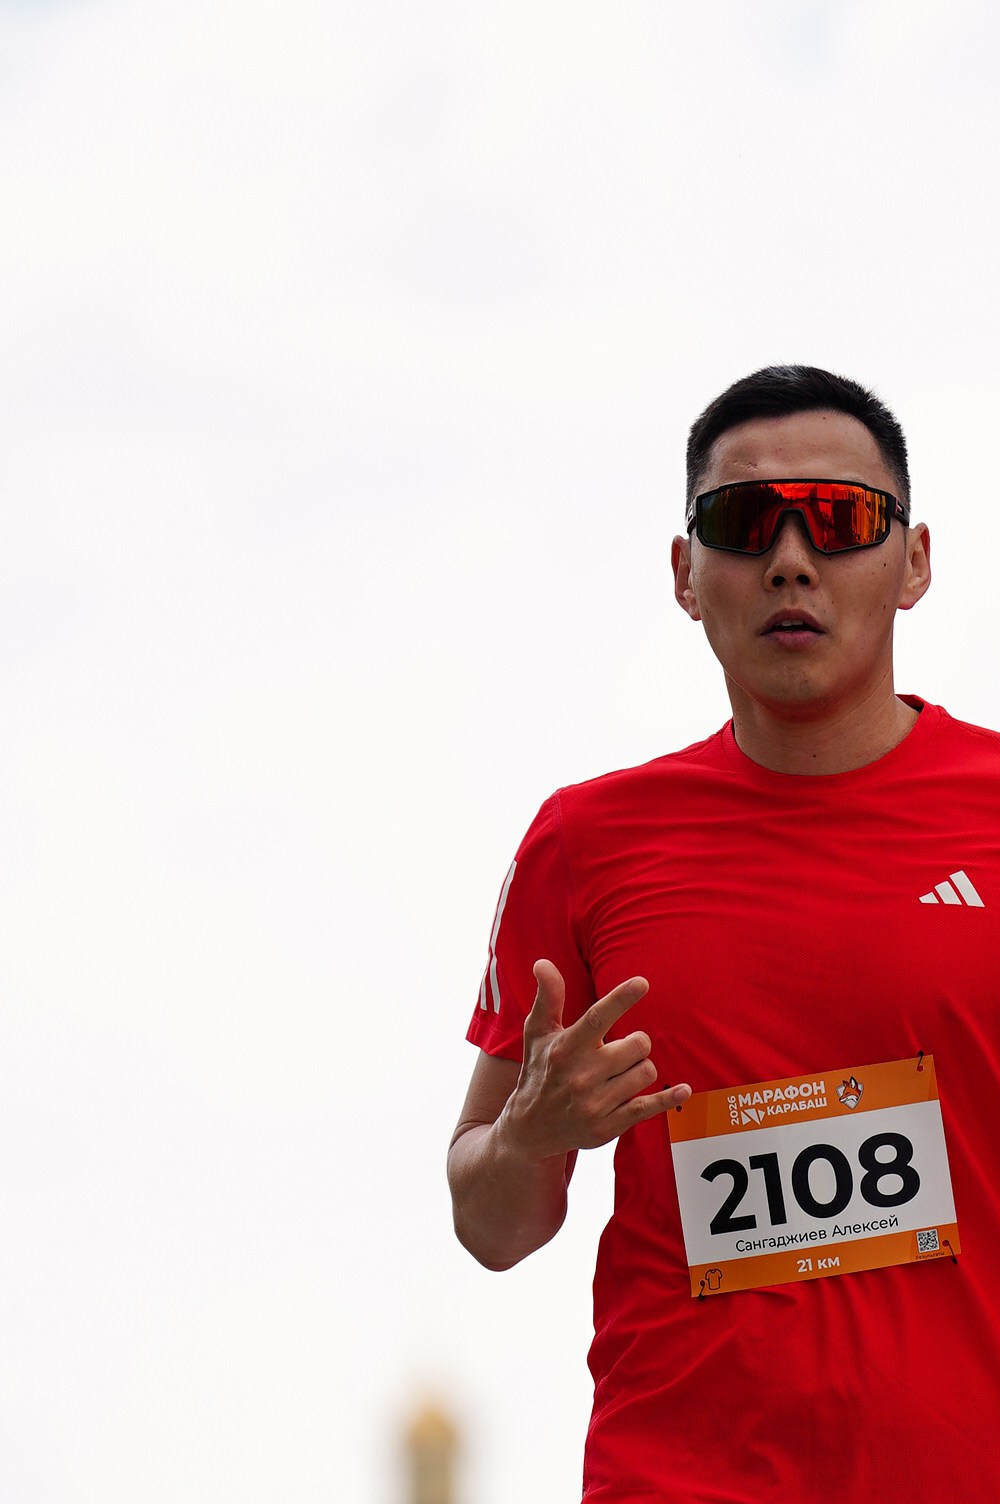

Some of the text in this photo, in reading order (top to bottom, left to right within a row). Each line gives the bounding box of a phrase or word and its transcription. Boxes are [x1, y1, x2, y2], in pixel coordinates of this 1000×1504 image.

[738, 1080, 826, 1108] МАРАФОН
[766, 1097, 828, 1116] КАРАБАШ
[727, 1095, 740, 1126] 2026
[700, 1132, 921, 1236] 2108
[735, 1214, 899, 1252] Сангаджиев Алексей
[796, 1258, 813, 1273] 21
